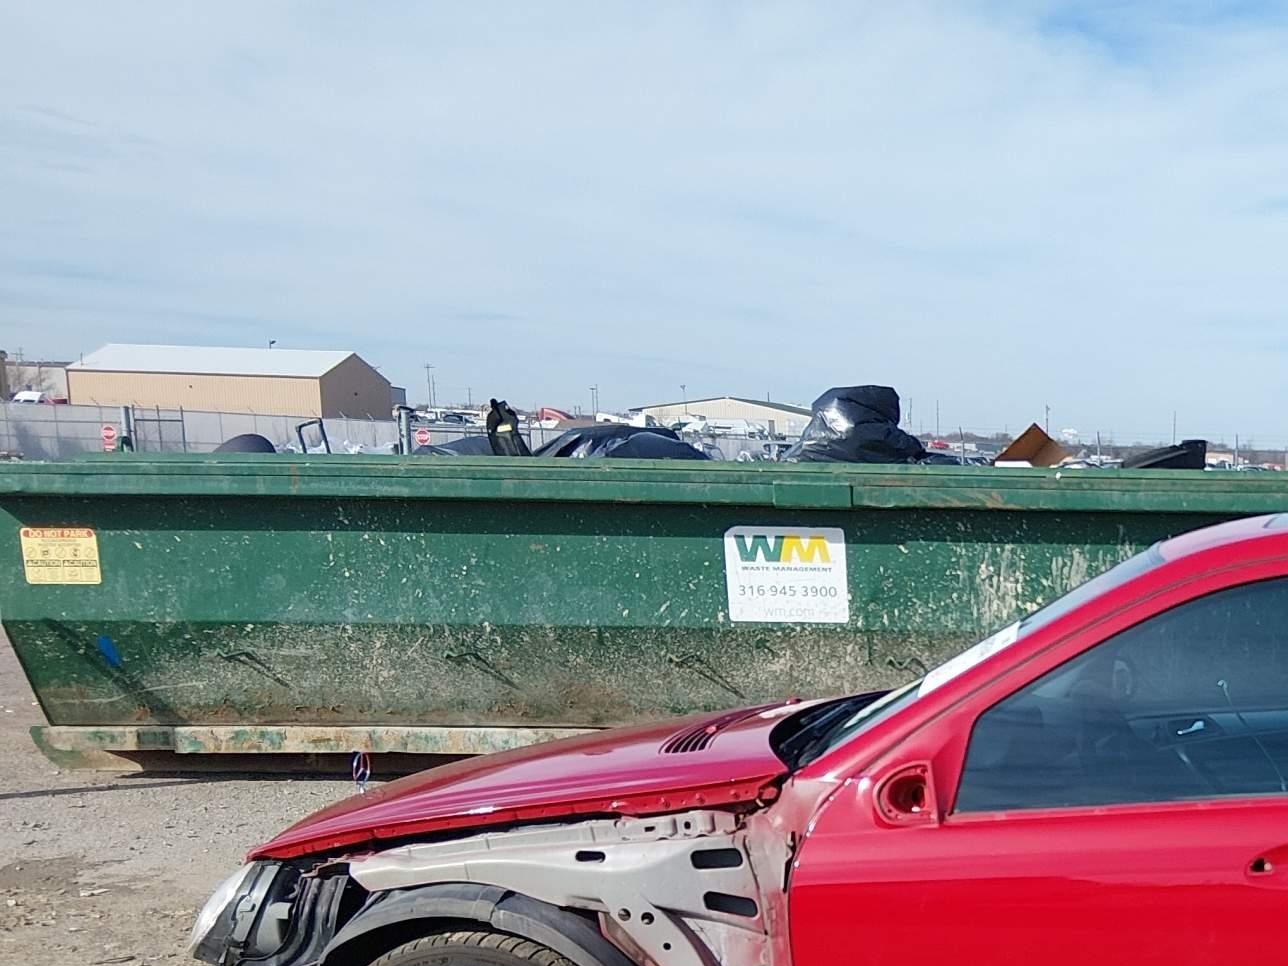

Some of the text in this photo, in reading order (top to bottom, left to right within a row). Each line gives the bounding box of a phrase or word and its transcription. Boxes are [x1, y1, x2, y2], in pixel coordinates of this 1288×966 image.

[733, 534, 832, 563] WM
[739, 585, 838, 598] 316 945 3900
